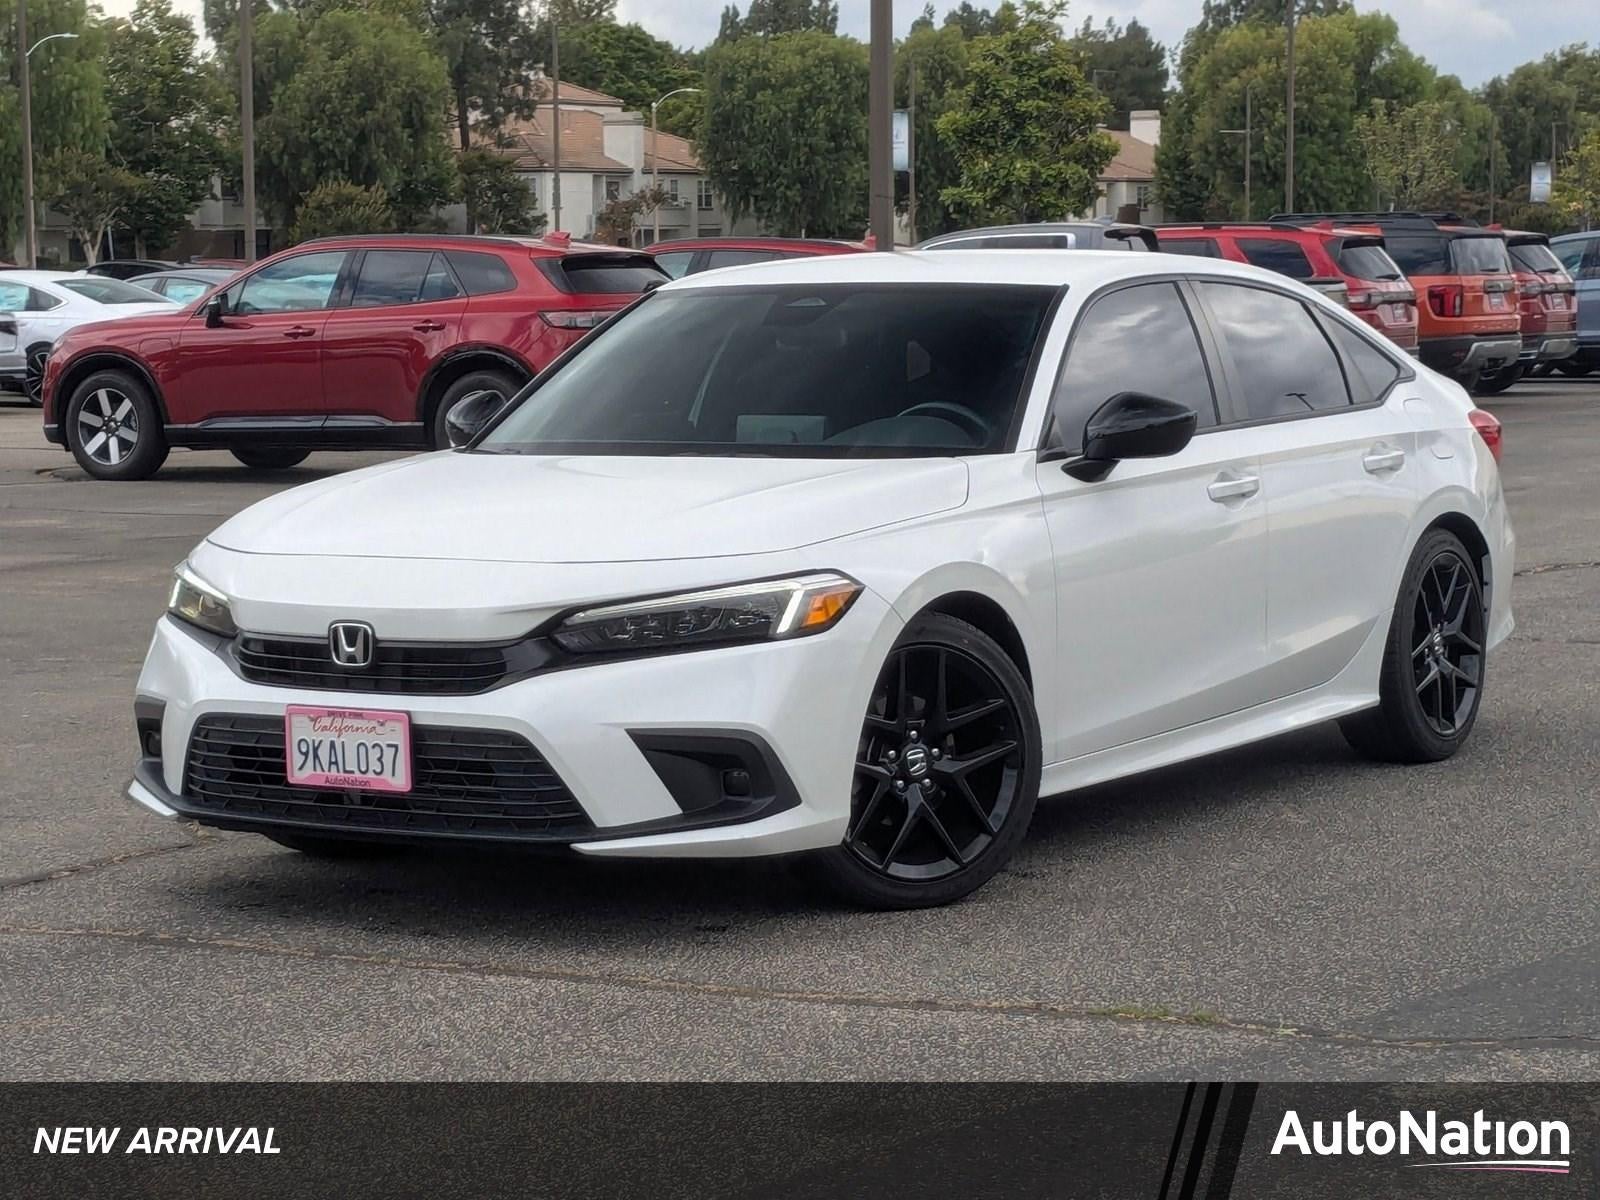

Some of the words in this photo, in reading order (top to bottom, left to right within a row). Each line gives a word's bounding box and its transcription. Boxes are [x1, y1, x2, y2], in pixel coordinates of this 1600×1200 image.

[312, 714, 384, 738] California
[297, 737, 399, 777] 9KAL037
[324, 775, 371, 788] AutoNation
